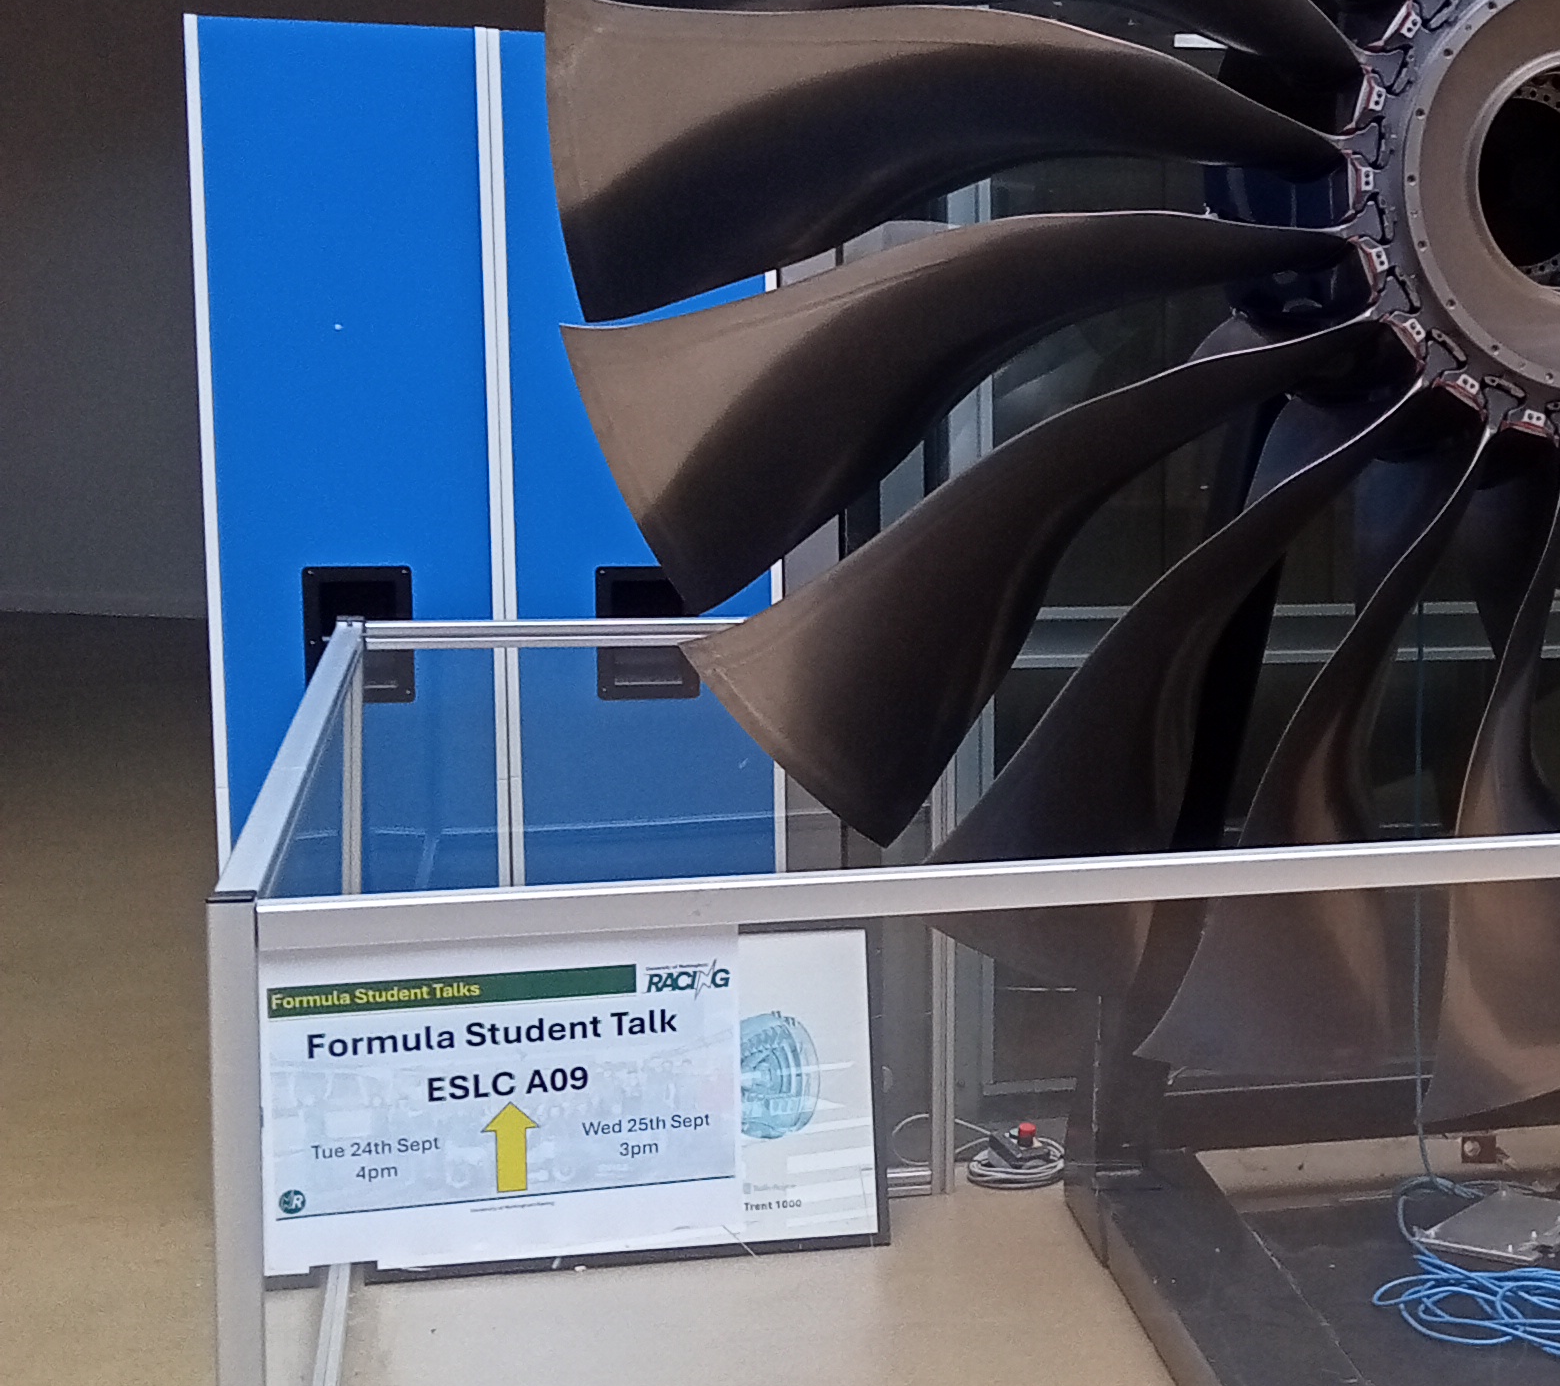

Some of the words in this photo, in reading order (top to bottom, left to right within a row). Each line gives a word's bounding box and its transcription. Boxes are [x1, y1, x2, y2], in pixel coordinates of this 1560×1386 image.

[271, 990, 351, 1010] Formula
[354, 985, 430, 1004] Student
[432, 981, 481, 998] Talks
[307, 1025, 455, 1059] Formula
[465, 1017, 602, 1047] Student
[610, 1008, 678, 1037] Talk
[428, 1071, 516, 1102] ESLC
[525, 1066, 589, 1095] A09
[581, 1119, 622, 1136] Wed
[627, 1116, 666, 1133] 25th
[670, 1113, 710, 1130] Sept
[311, 1145, 345, 1160] Tue
[350, 1140, 392, 1157] 24th
[397, 1137, 441, 1154] Sept
[619, 1142, 659, 1158] 3pm
[355, 1166, 398, 1182] 4pm
[743, 1201, 773, 1211] Trent
[775, 1199, 802, 1209] 1000
